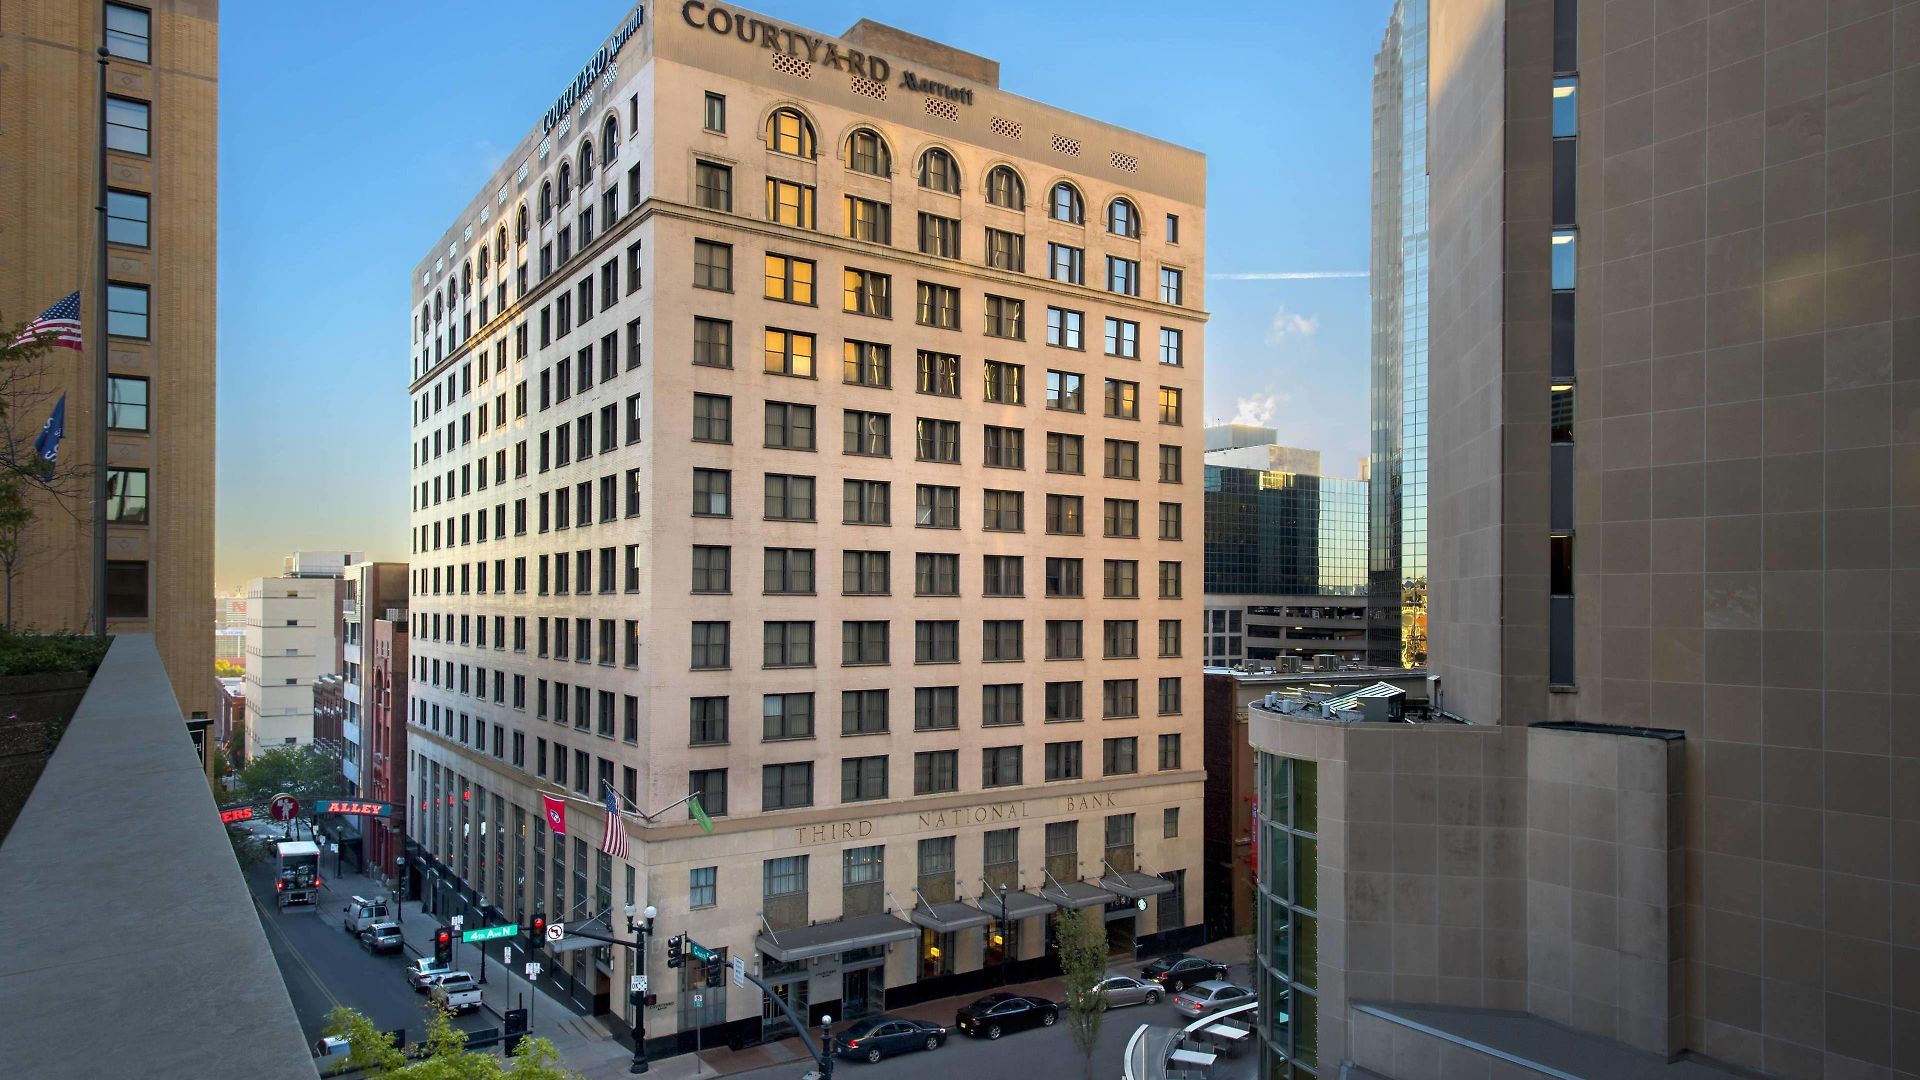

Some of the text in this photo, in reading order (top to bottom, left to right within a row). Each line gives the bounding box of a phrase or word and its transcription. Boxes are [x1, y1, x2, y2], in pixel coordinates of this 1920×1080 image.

[542, 4, 644, 135] COURTYARD Marriott
[682, 0, 975, 106] COURTYARD Marriott
[328, 801, 382, 815] ALLEY
[795, 793, 1118, 844] THIRD NATIONAL BANK
[502, 926, 511, 936] N
